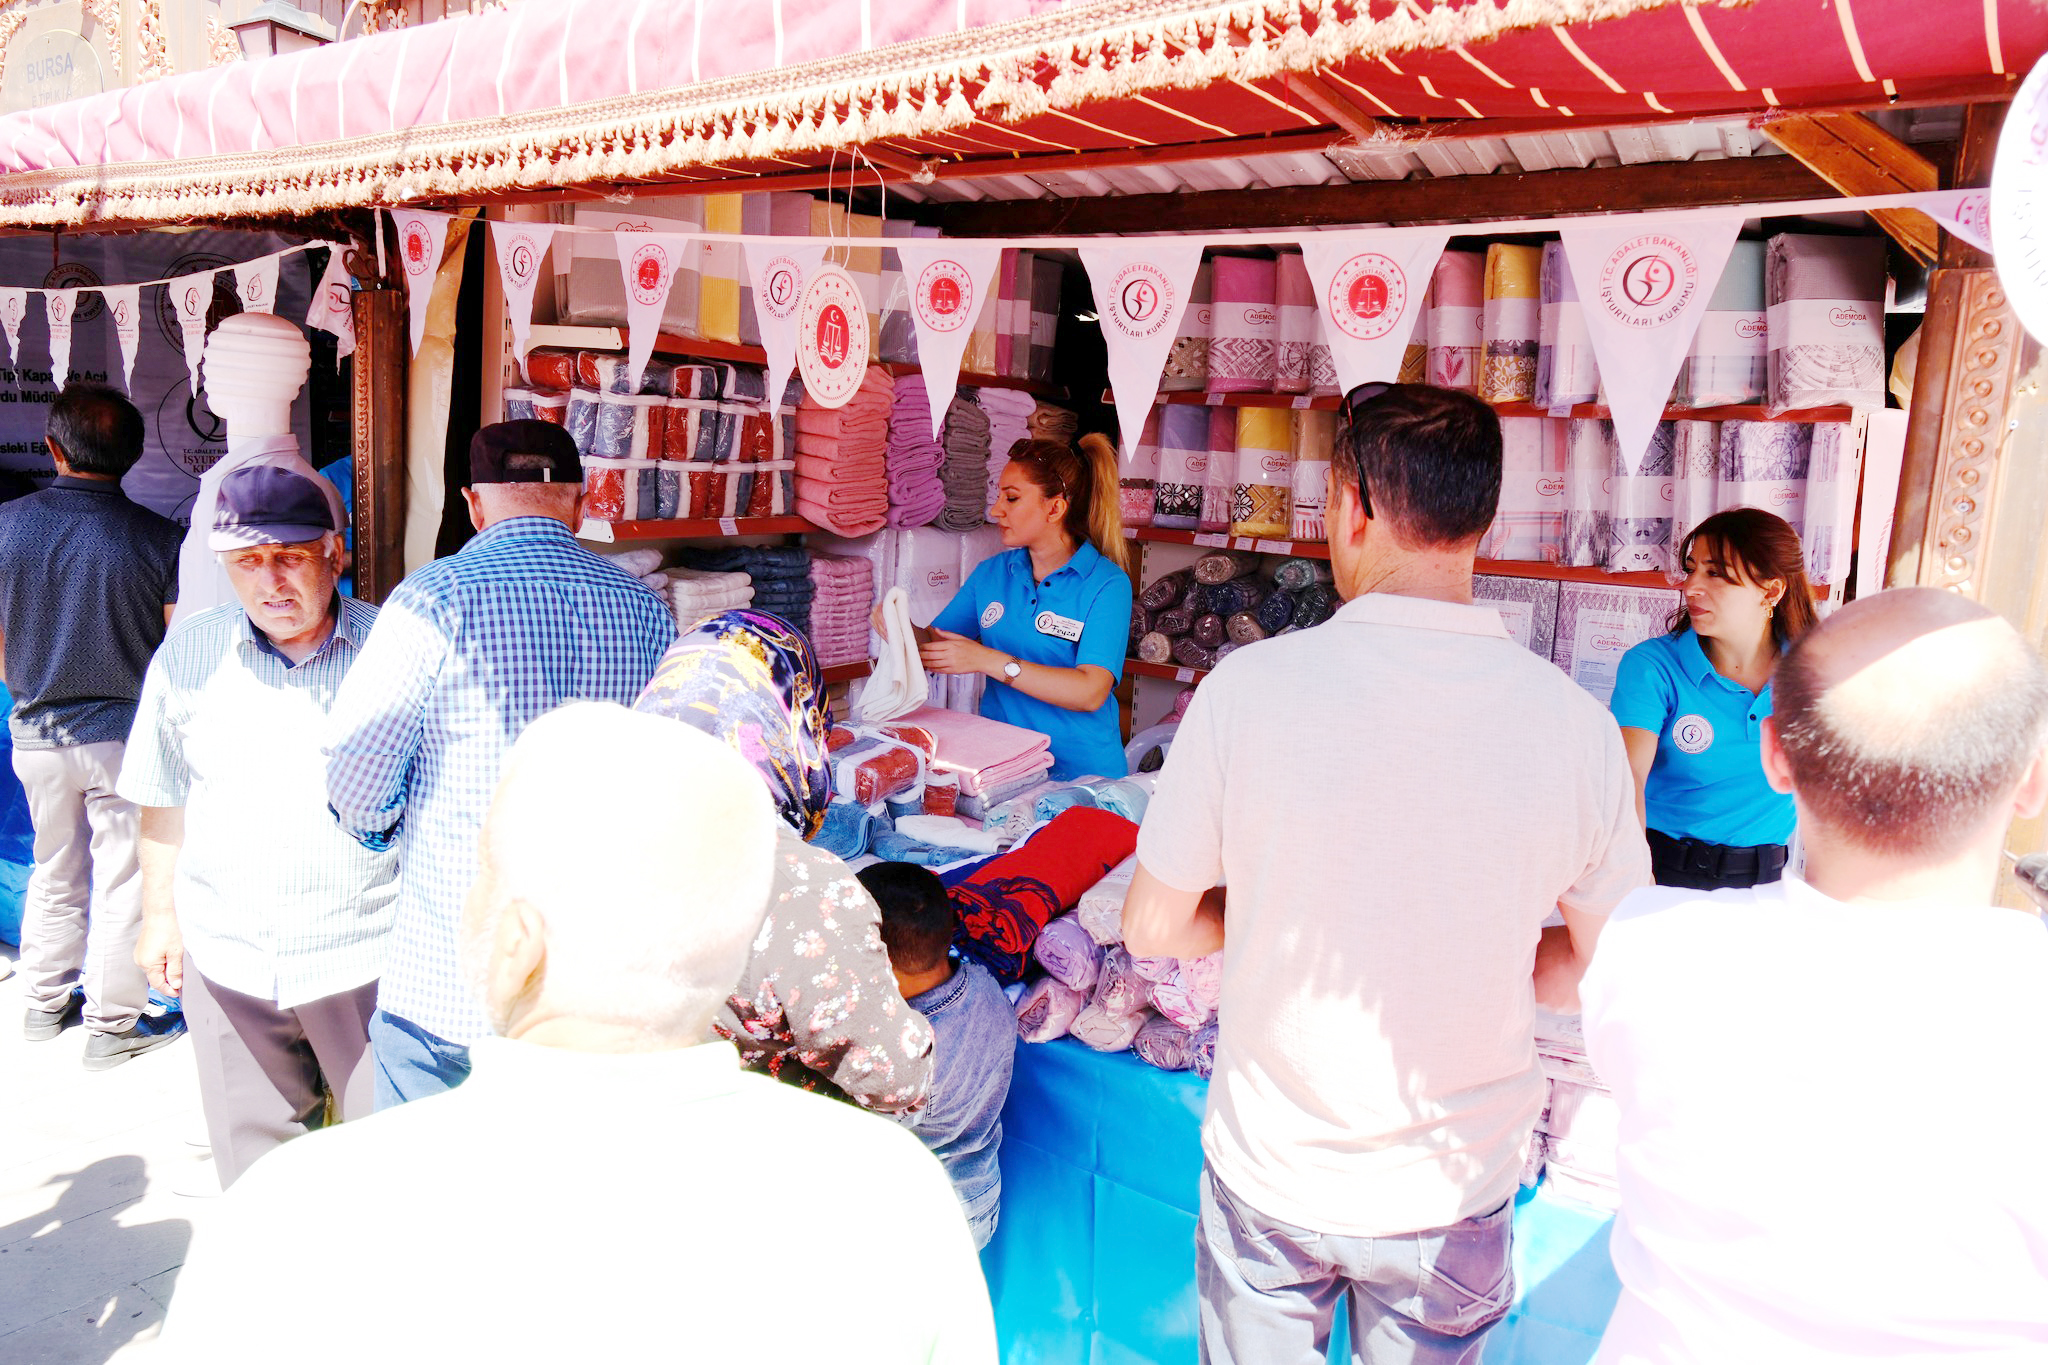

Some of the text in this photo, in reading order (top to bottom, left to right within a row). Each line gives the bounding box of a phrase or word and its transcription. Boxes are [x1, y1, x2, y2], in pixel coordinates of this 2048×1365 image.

[26, 52, 74, 84] BURSA
[1612, 236, 1650, 264] ADALET
[1115, 264, 1141, 286] ADALET
[1658, 281, 1695, 323] KURUMU
[1146, 303, 1173, 336] KURUMU
[1835, 313, 1867, 321] ADEMODA
[1596, 639, 1631, 648] ADEMODA
